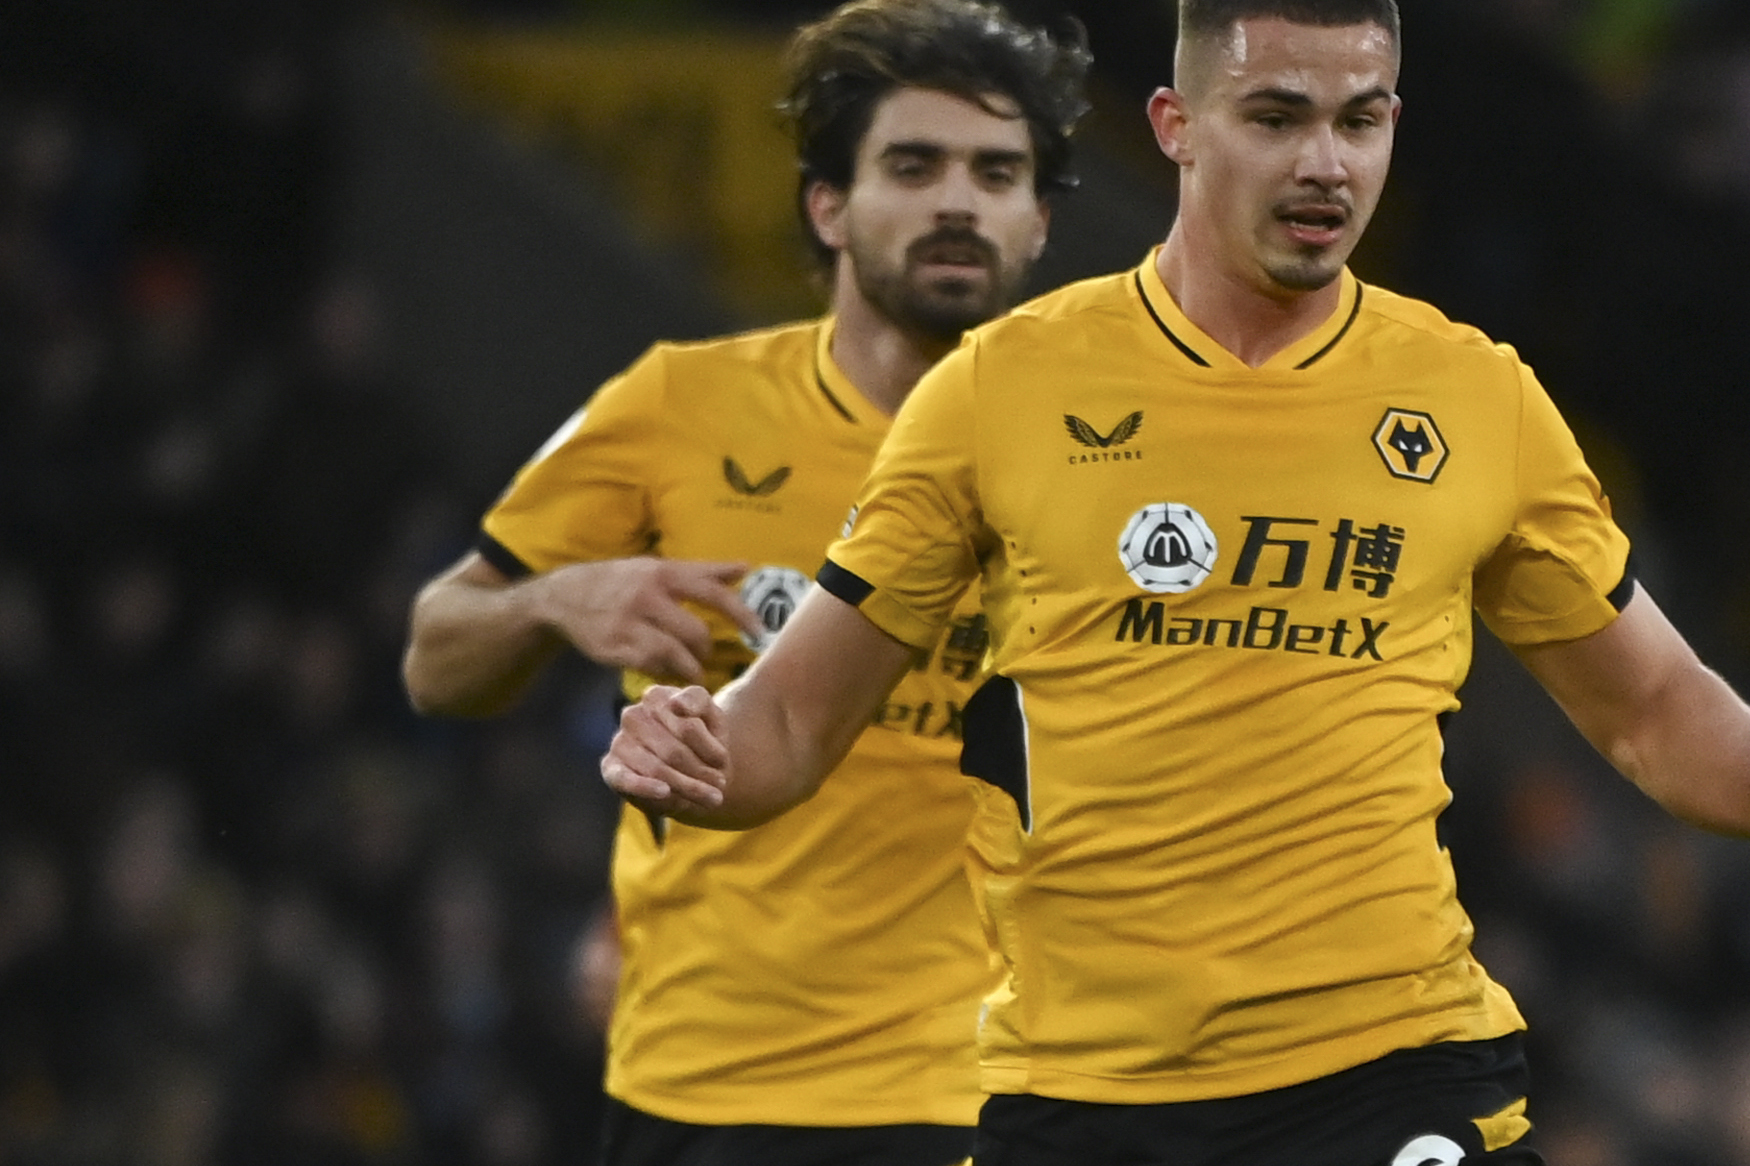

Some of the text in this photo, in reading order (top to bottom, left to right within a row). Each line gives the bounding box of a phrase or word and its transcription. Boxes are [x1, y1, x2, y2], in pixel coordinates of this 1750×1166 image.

[1068, 450, 1143, 465] CASTORE
[1230, 515, 1406, 599] 万博
[1115, 598, 1390, 662] ManBetX
